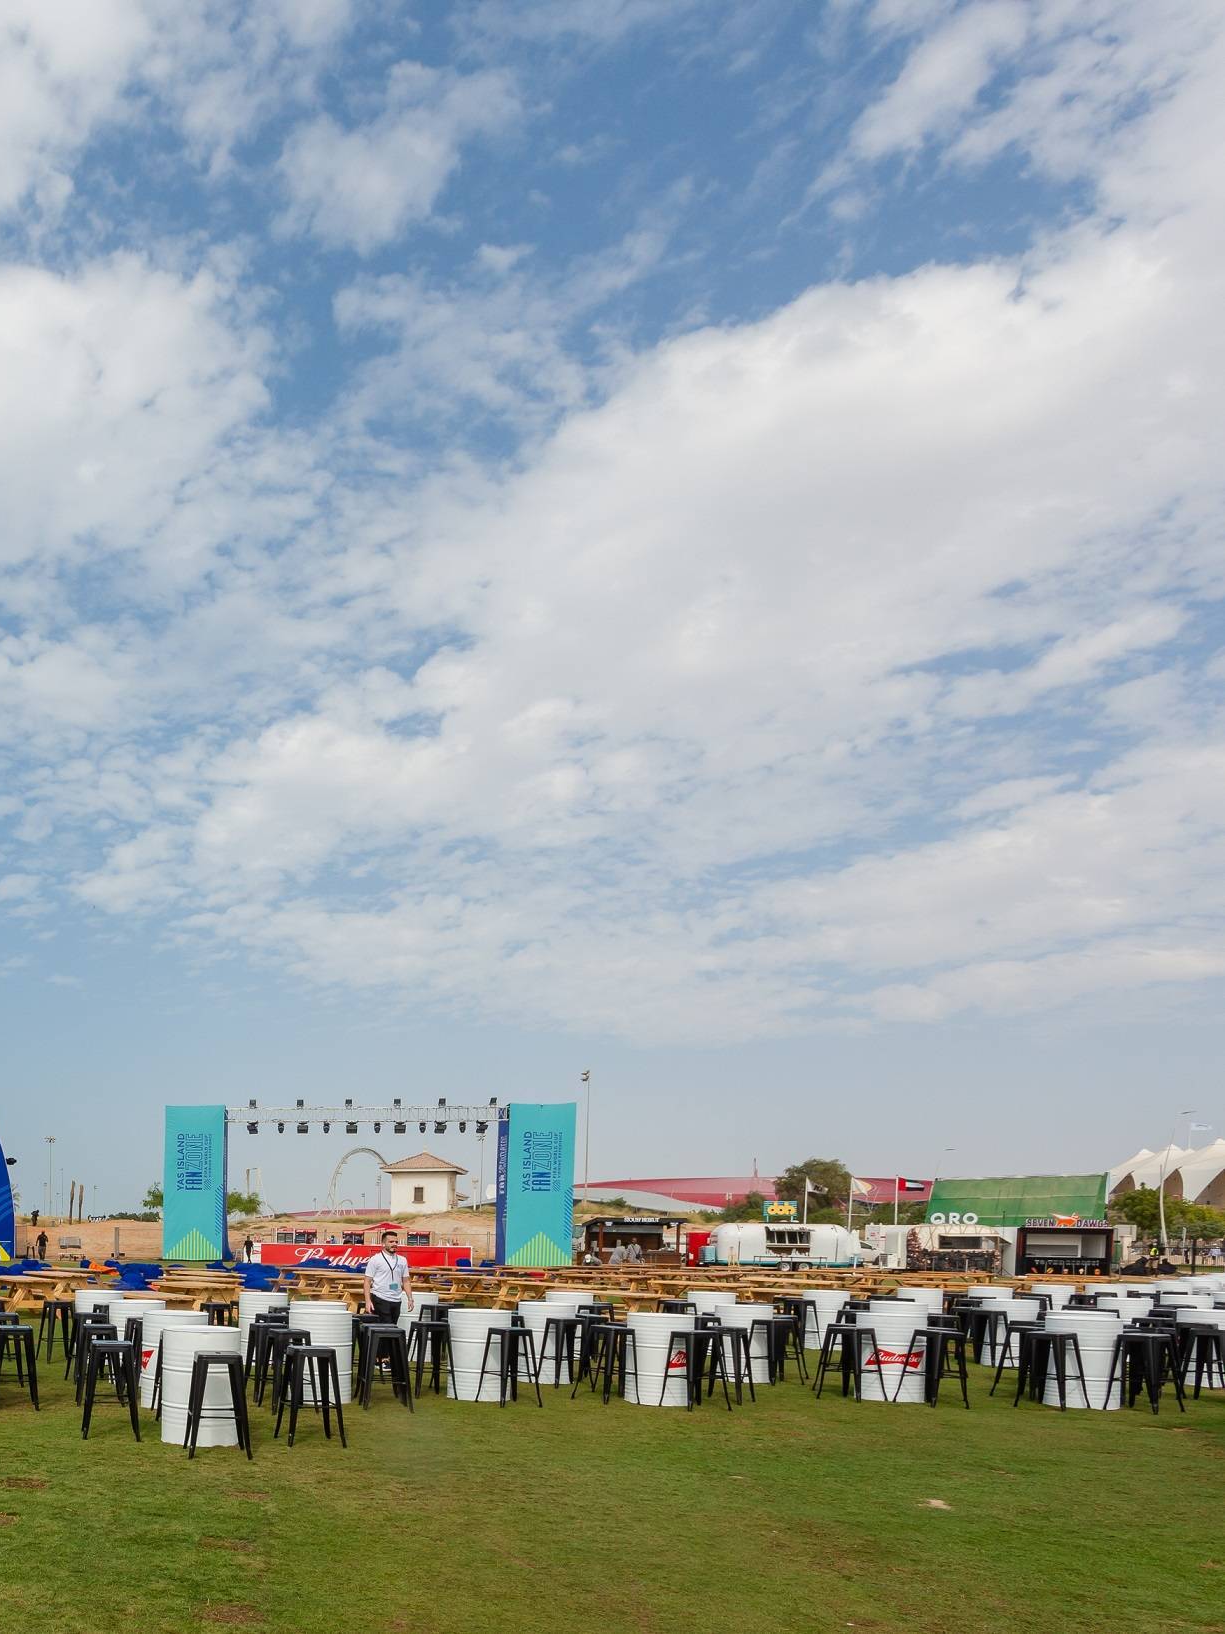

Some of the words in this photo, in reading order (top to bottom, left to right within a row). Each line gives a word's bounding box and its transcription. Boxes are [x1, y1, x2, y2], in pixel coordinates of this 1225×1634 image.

[176, 1133, 185, 1169] ISLAND
[523, 1131, 532, 1170] ISLAND
[176, 1172, 185, 1191] YAS
[522, 1173, 531, 1192] YAS
[1025, 1218, 1055, 1228] SEVEN
[1076, 1219, 1109, 1228] DAWGS
